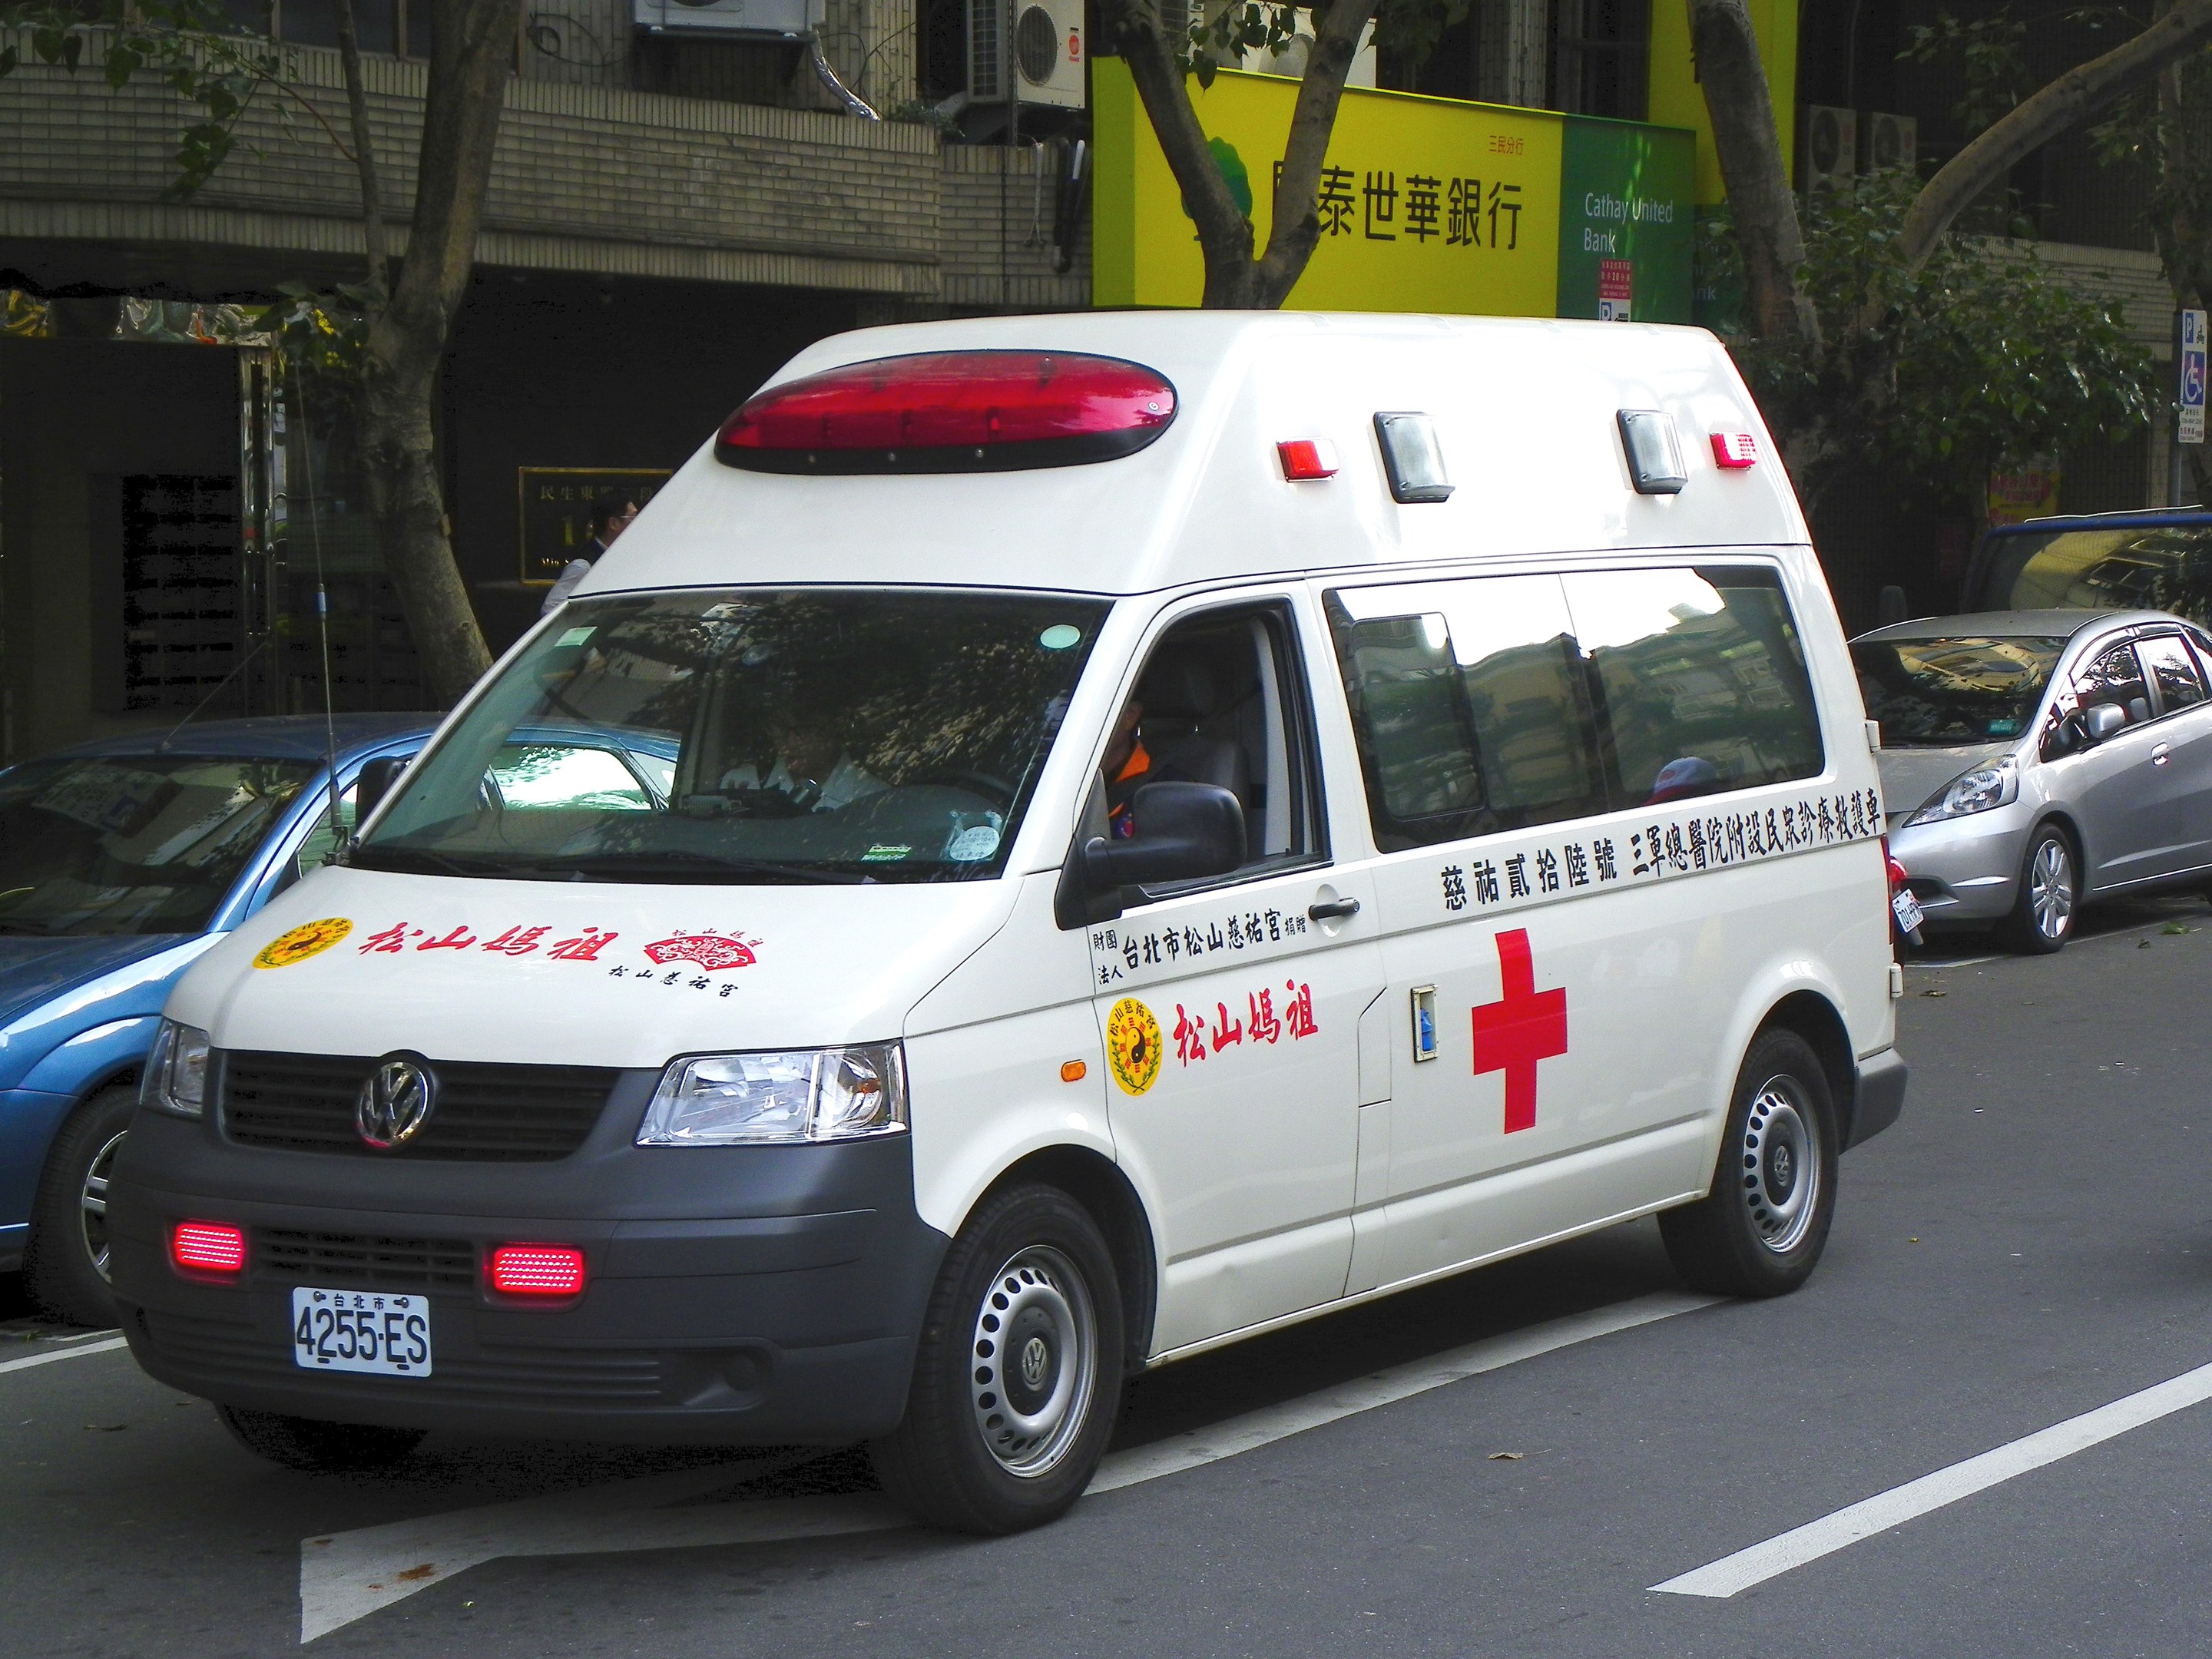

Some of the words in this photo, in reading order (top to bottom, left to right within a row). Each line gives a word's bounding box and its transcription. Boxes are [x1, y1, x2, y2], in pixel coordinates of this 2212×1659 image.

[1489, 135, 1524, 155] 三民分行
[1272, 160, 1522, 250] 泰世華銀行
[1585, 192, 1628, 225] Cathay
[1632, 197, 1673, 223] United
[1584, 227, 1616, 253] Bank
[2186, 317, 2194, 339] P
[1441, 837, 1618, 911] 慈祐貳拾陸號
[358, 922, 619, 961] 松山媽祖
[1093, 929, 1118, 951] 財團
[1122, 907, 1281, 970] 台北市松山慈祐宮
[1284, 914, 1306, 935] 捐贈
[609, 965, 739, 998] 松山慈祐宮
[1098, 965, 1124, 985] 法人
[1174, 979, 1319, 1068] 松山媽祖
[334, 1293, 385, 1310] 台北市
[296, 1306, 428, 1364] 4255-ES
